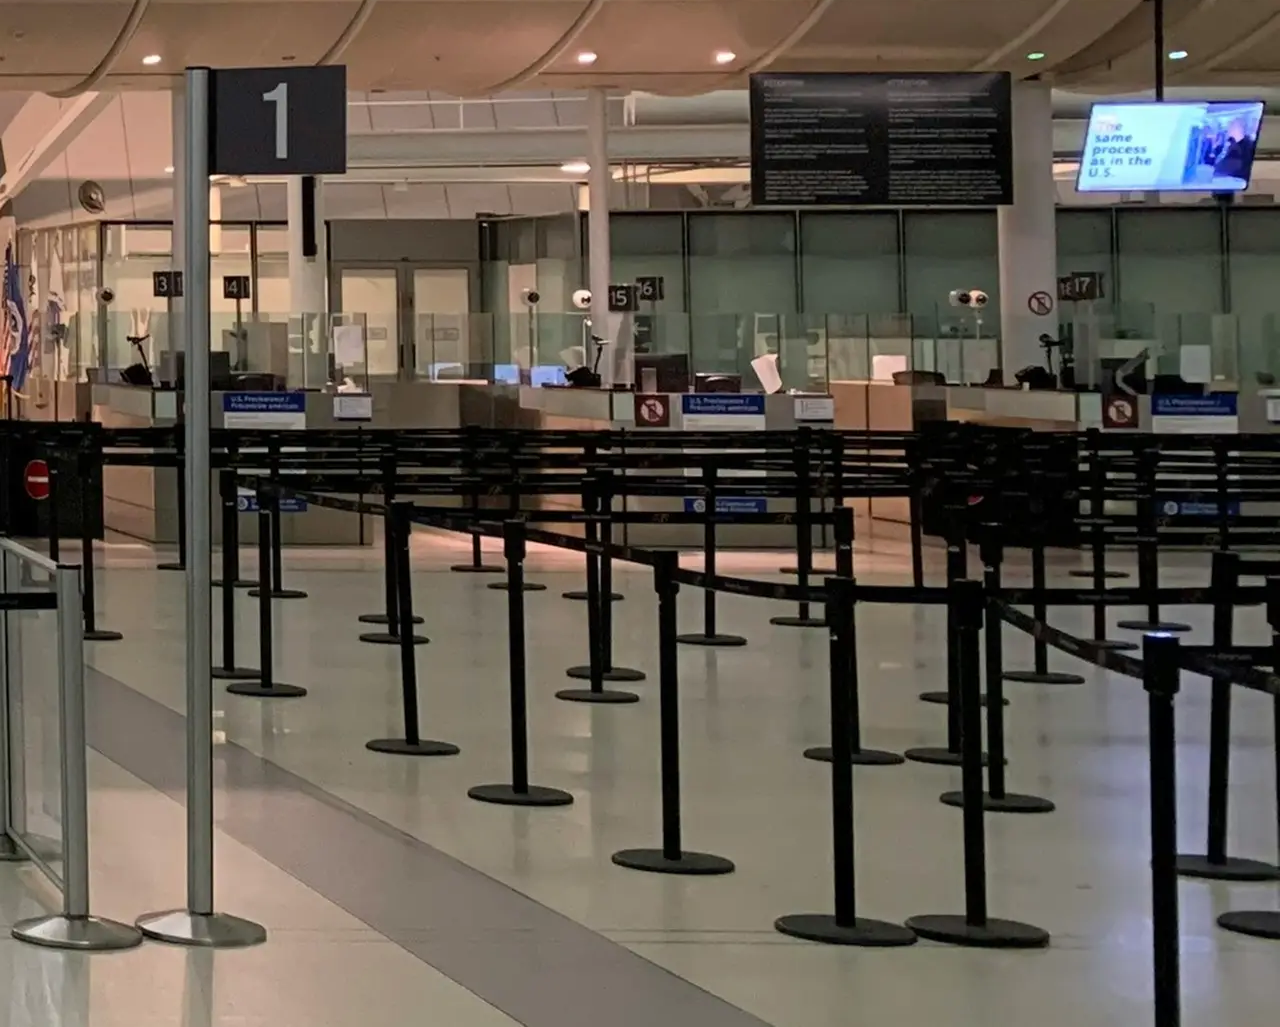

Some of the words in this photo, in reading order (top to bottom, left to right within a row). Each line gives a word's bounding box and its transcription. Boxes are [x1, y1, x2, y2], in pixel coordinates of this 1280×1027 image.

[262, 81, 288, 159] 1
[1094, 133, 1133, 143] same
[1092, 144, 1147, 156] process
[1090, 157, 1105, 166] as
[1111, 156, 1124, 165] in
[1128, 156, 1152, 166] the
[1074, 276, 1091, 294] 17
[610, 289, 628, 306] 15
